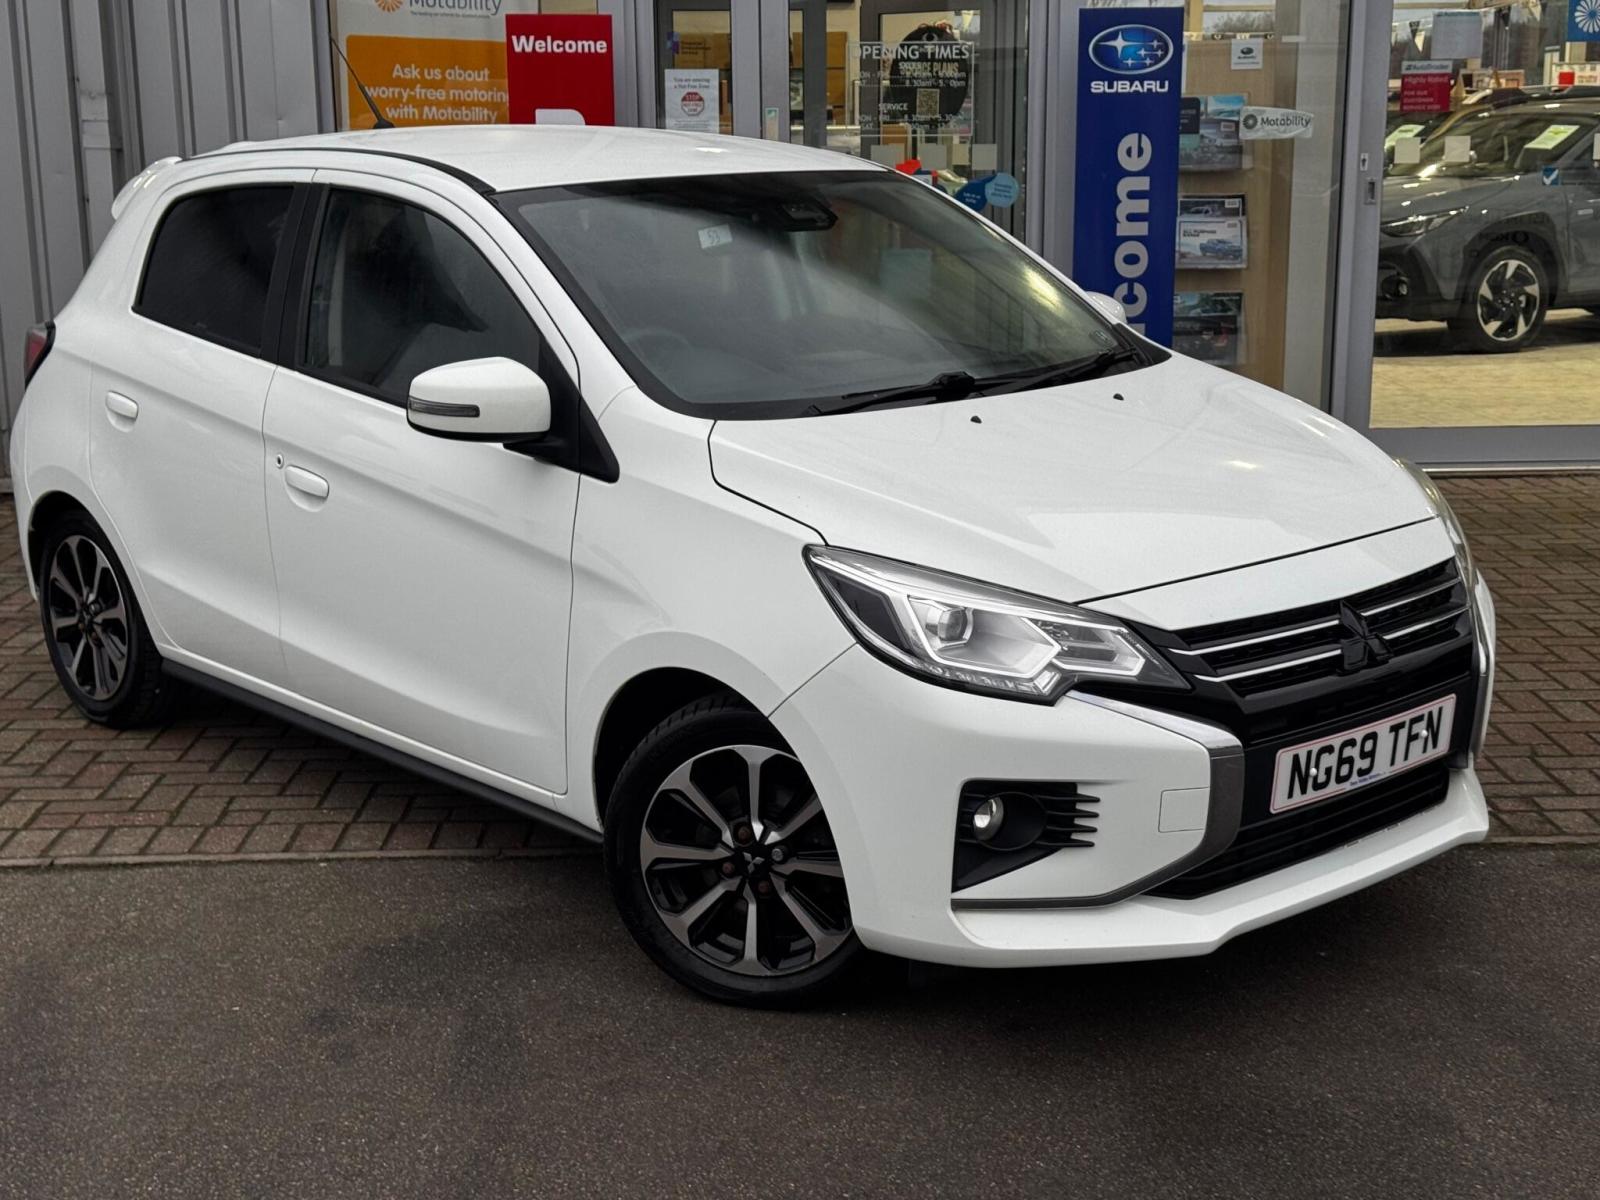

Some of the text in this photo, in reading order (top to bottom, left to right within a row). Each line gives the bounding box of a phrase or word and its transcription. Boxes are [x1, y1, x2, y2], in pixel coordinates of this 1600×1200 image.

[512, 35, 607, 53] Welcome
[924, 45, 970, 60] TIMES
[392, 64, 490, 82] Ask us about
[365, 86, 446, 101] worry-free
[1090, 80, 1169, 93] SUBARU
[386, 104, 498, 123] with Motability
[1260, 115, 1311, 127] Motability
[1287, 706, 1443, 799] NG69 TFN
